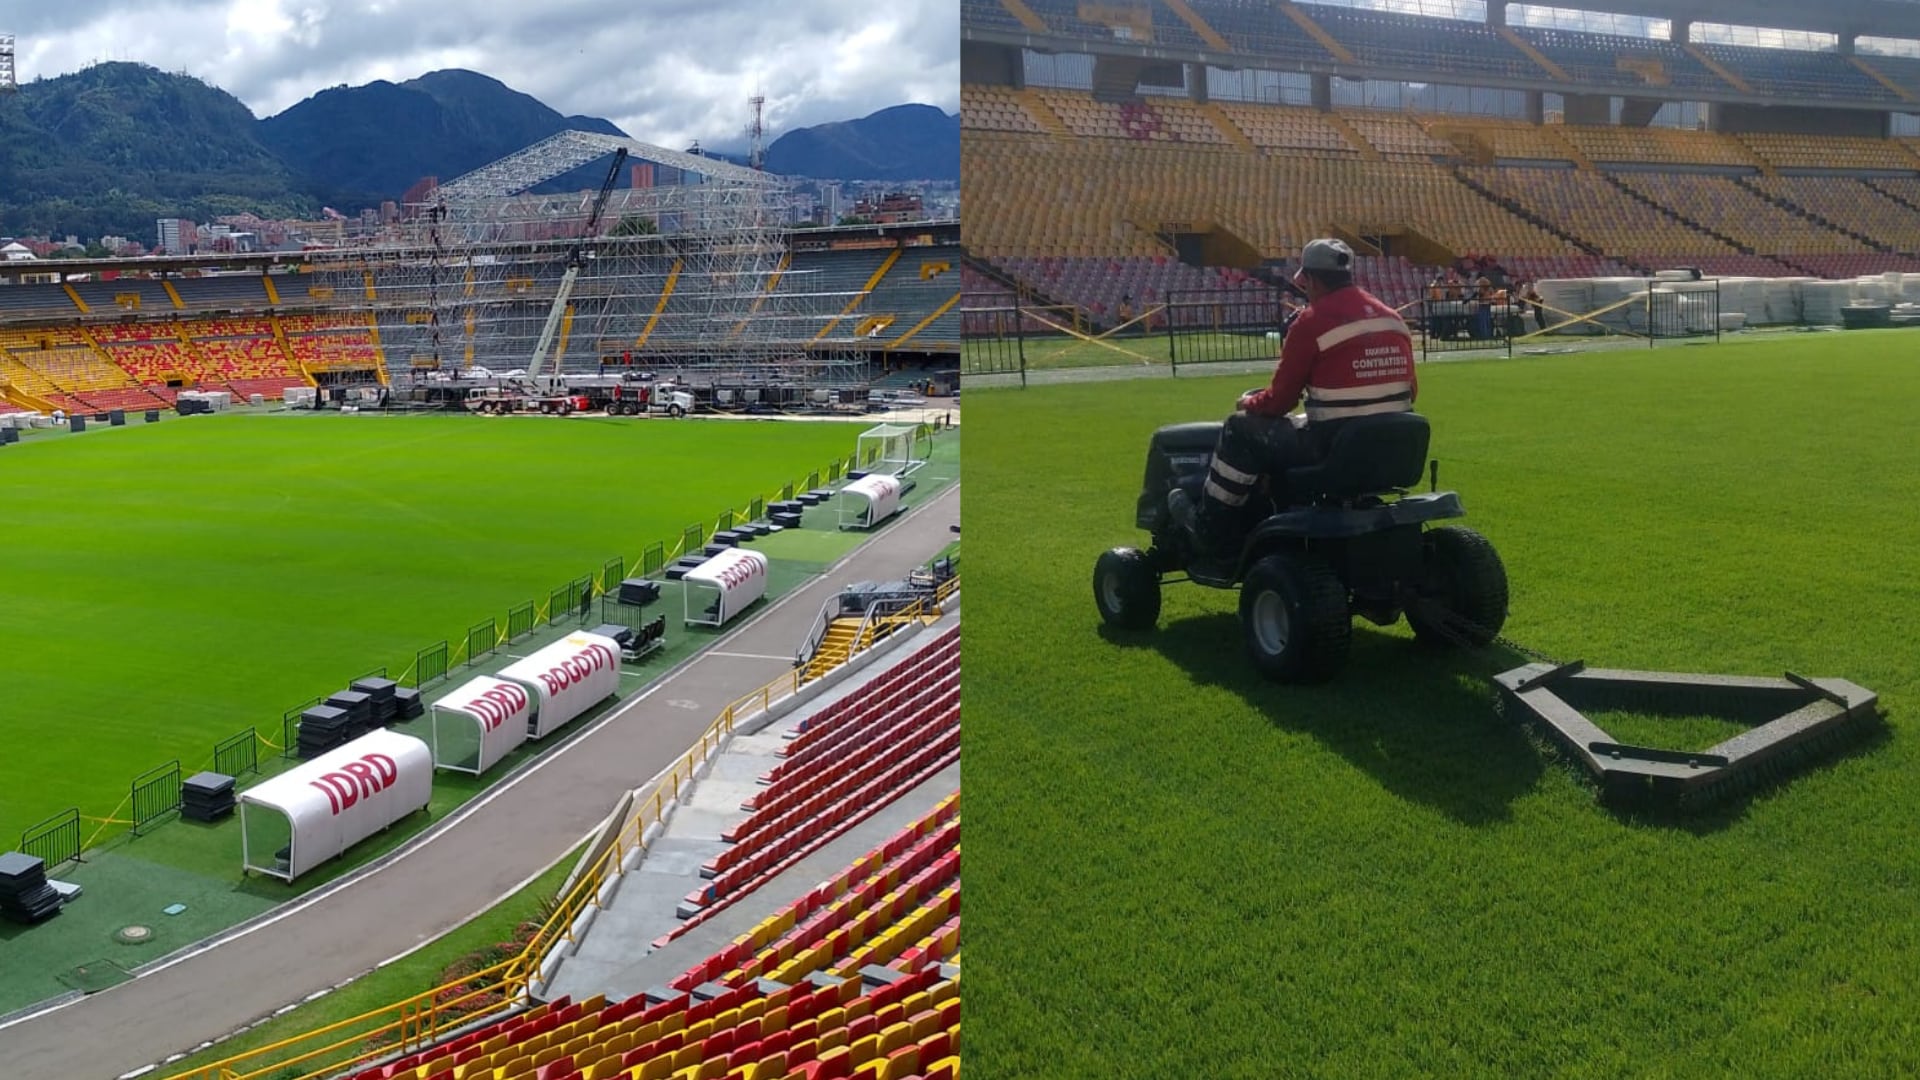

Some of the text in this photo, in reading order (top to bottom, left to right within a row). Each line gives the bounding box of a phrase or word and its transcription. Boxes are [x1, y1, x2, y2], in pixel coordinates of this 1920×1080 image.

[1352, 356, 1408, 370] CONTRATISTA
[463, 683, 527, 733] IDRD
[310, 752, 397, 816] IDRD
